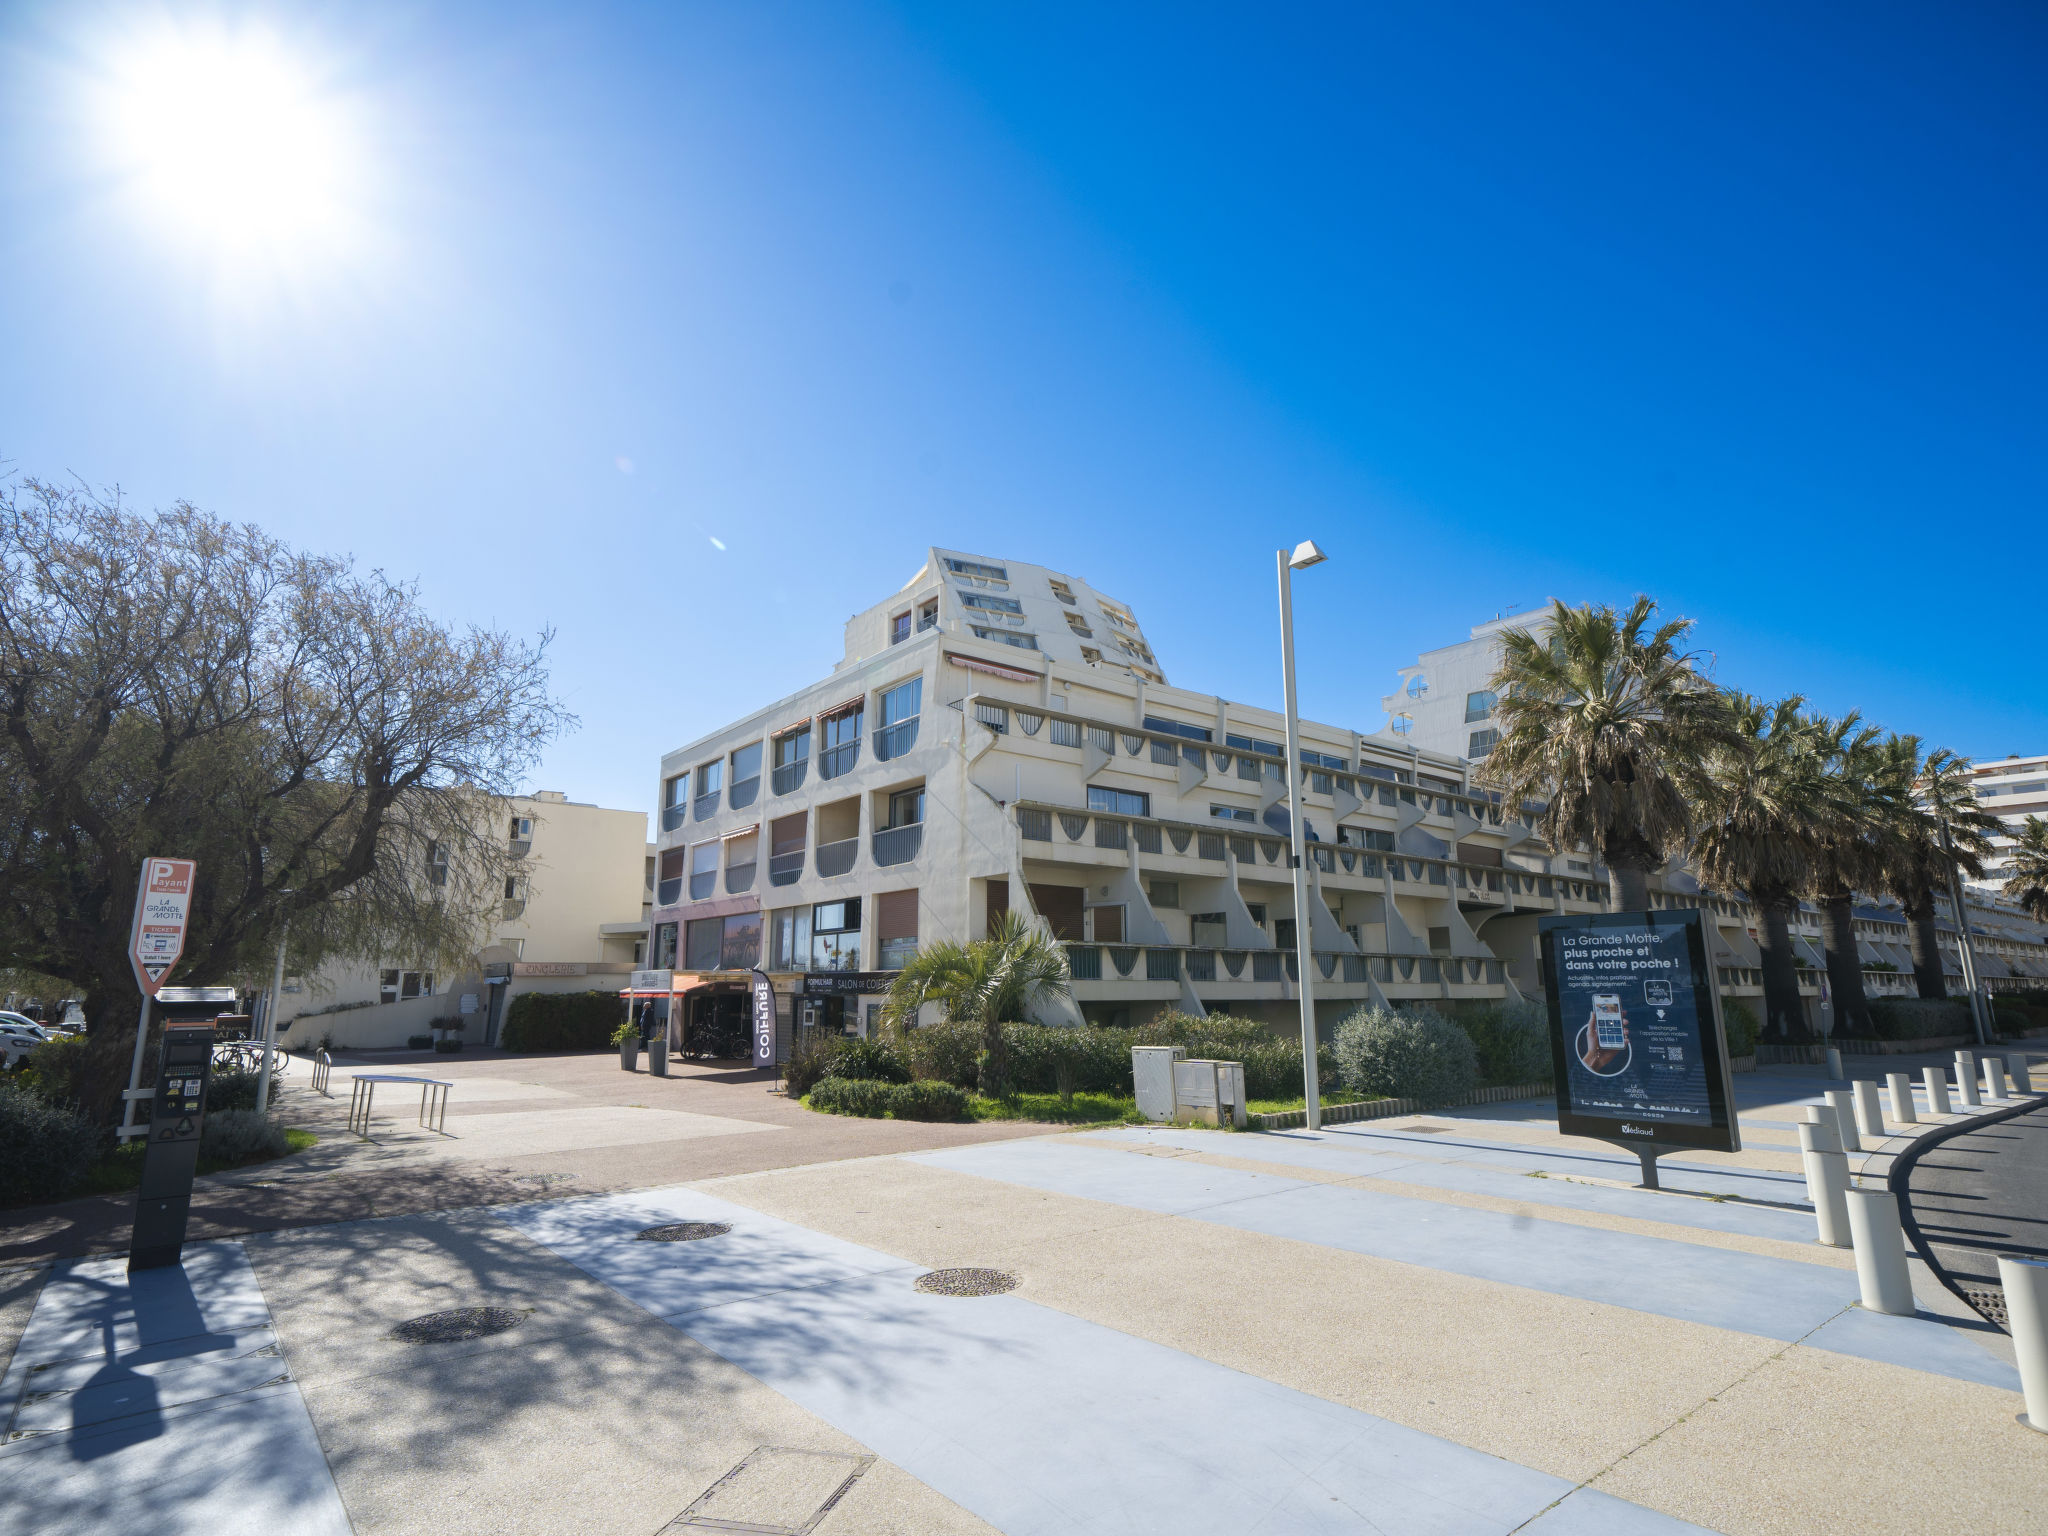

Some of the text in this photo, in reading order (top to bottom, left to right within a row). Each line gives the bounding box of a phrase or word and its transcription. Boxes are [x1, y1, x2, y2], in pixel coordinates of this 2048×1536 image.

[152, 863, 187, 887] Payant
[146, 905, 180, 913] GRANDE
[153, 912, 184, 920] MOTTE
[1562, 933, 1663, 946] La Grande Motte,
[1564, 946, 1649, 960] plus proche et
[1565, 958, 1680, 971] dans votre poche !
[837, 979, 858, 990] SALON
